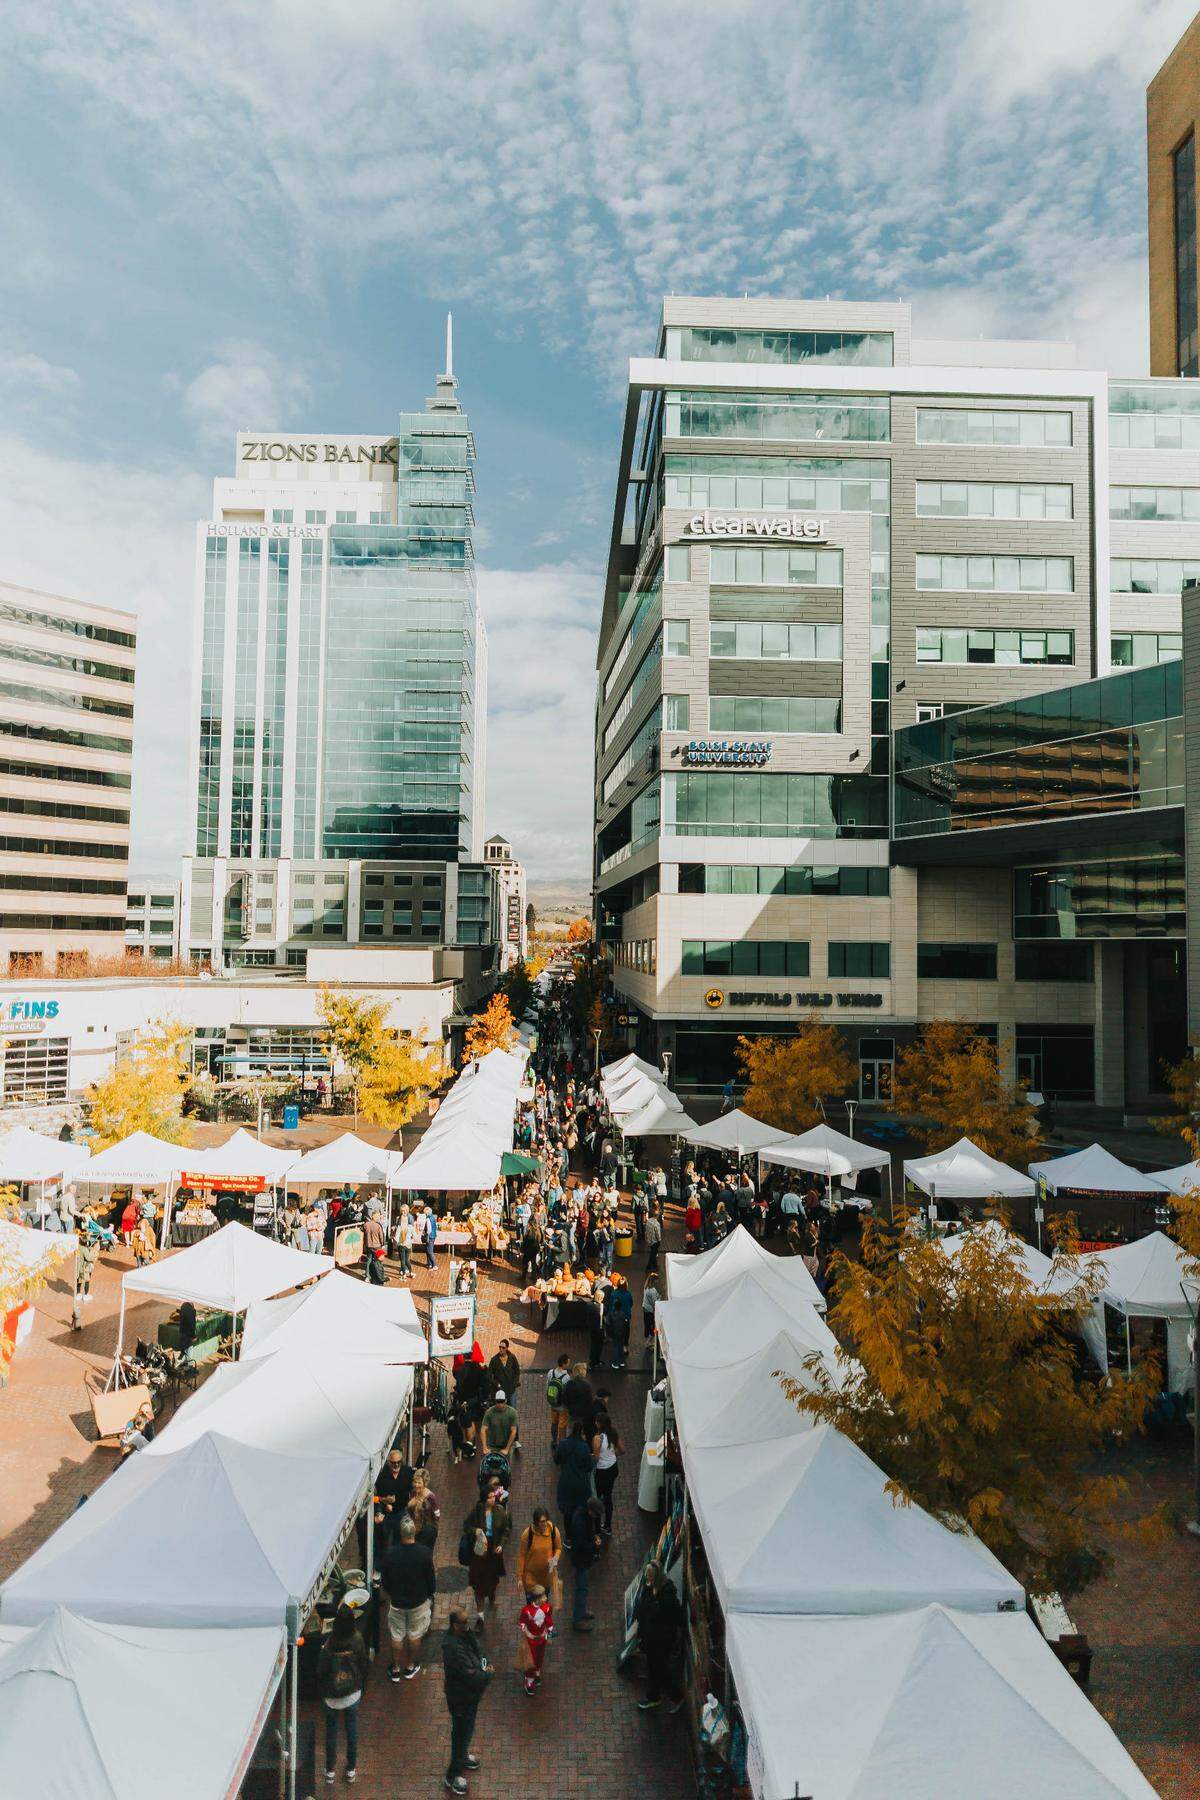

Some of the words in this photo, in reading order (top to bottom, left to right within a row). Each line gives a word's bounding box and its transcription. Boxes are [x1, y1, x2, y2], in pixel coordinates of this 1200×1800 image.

[242, 442, 317, 462] ZIONS
[324, 445, 399, 463] BANK
[207, 524, 268, 536] HOLLAND
[272, 526, 282, 537] &
[287, 526, 321, 538] HART
[690, 510, 828, 536] clearwater
[688, 741, 728, 751] BOISE
[733, 741, 773, 752] STATE
[688, 752, 772, 763] UNIVERSITY
[10, 1000, 60, 1019] FINS
